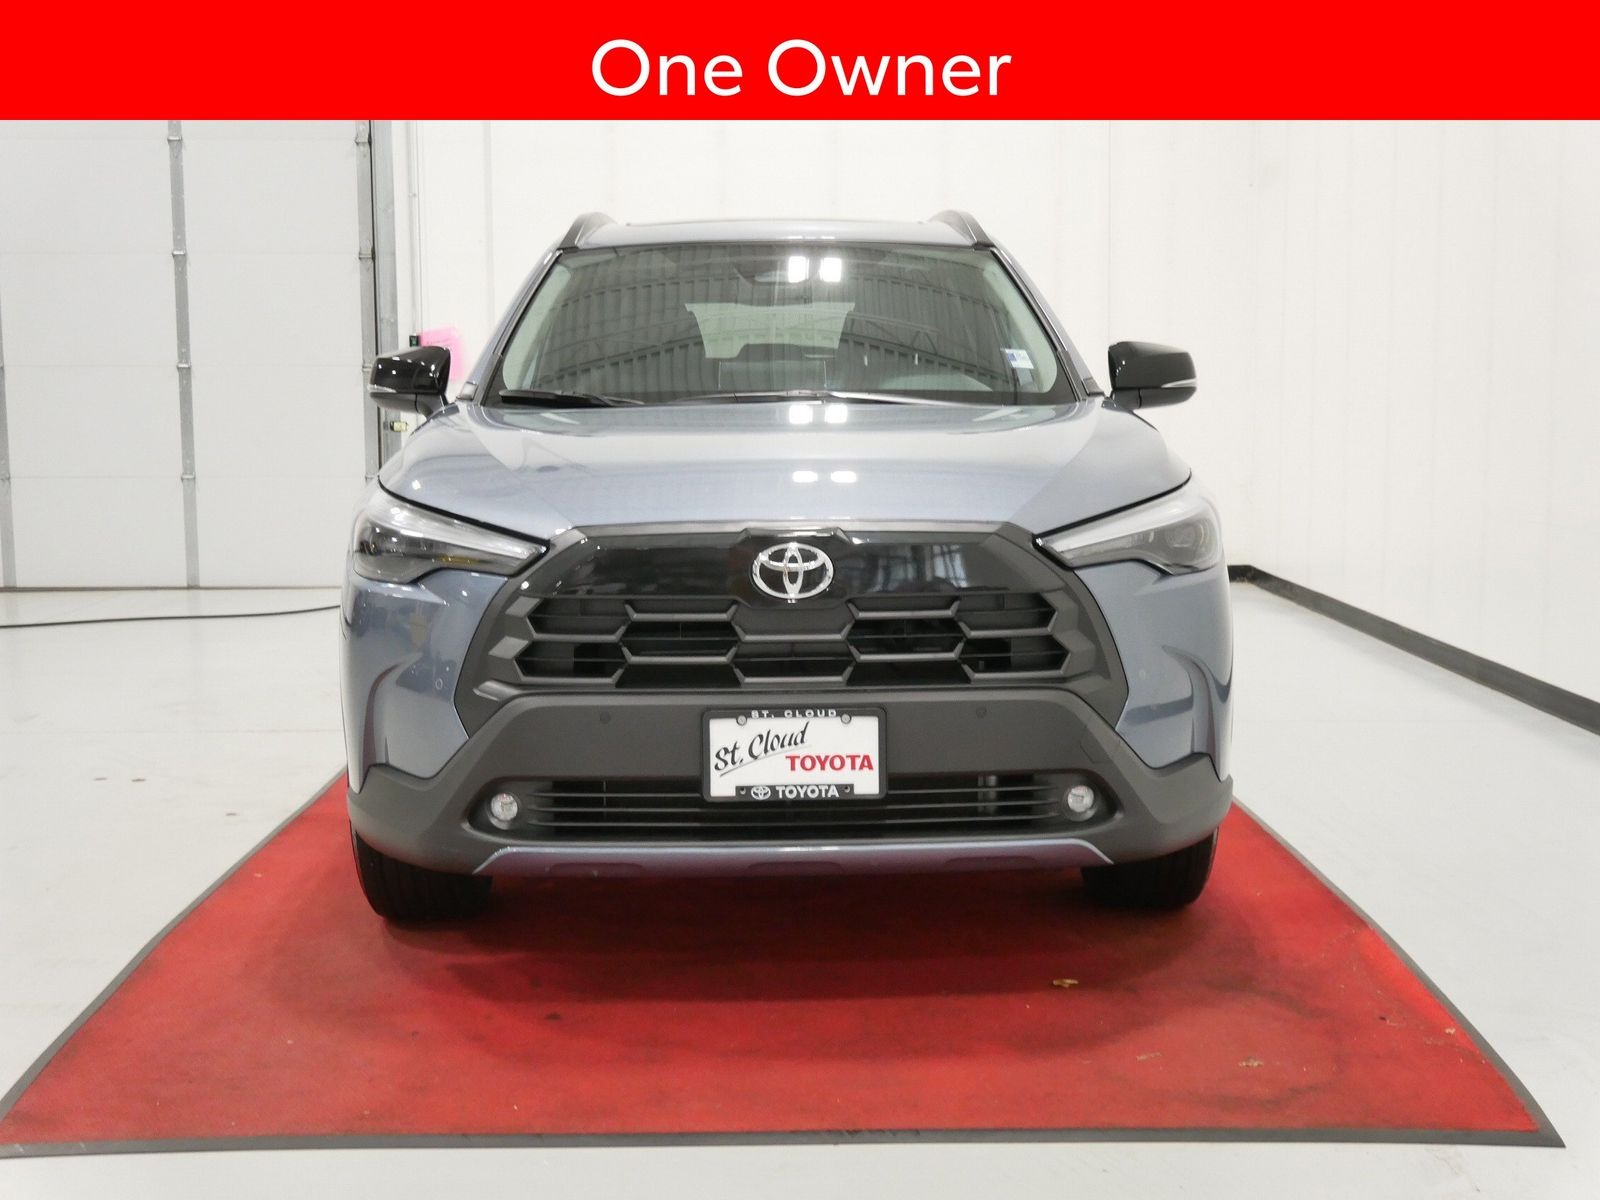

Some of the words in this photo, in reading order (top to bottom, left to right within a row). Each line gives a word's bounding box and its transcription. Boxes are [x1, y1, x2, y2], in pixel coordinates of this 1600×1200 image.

[750, 709, 775, 719] ST.
[784, 709, 837, 718] CLOUD
[714, 741, 744, 772] St.
[748, 721, 810, 760] Cloud
[786, 754, 874, 772] TOYOTA
[775, 785, 840, 799] TOYOTA
